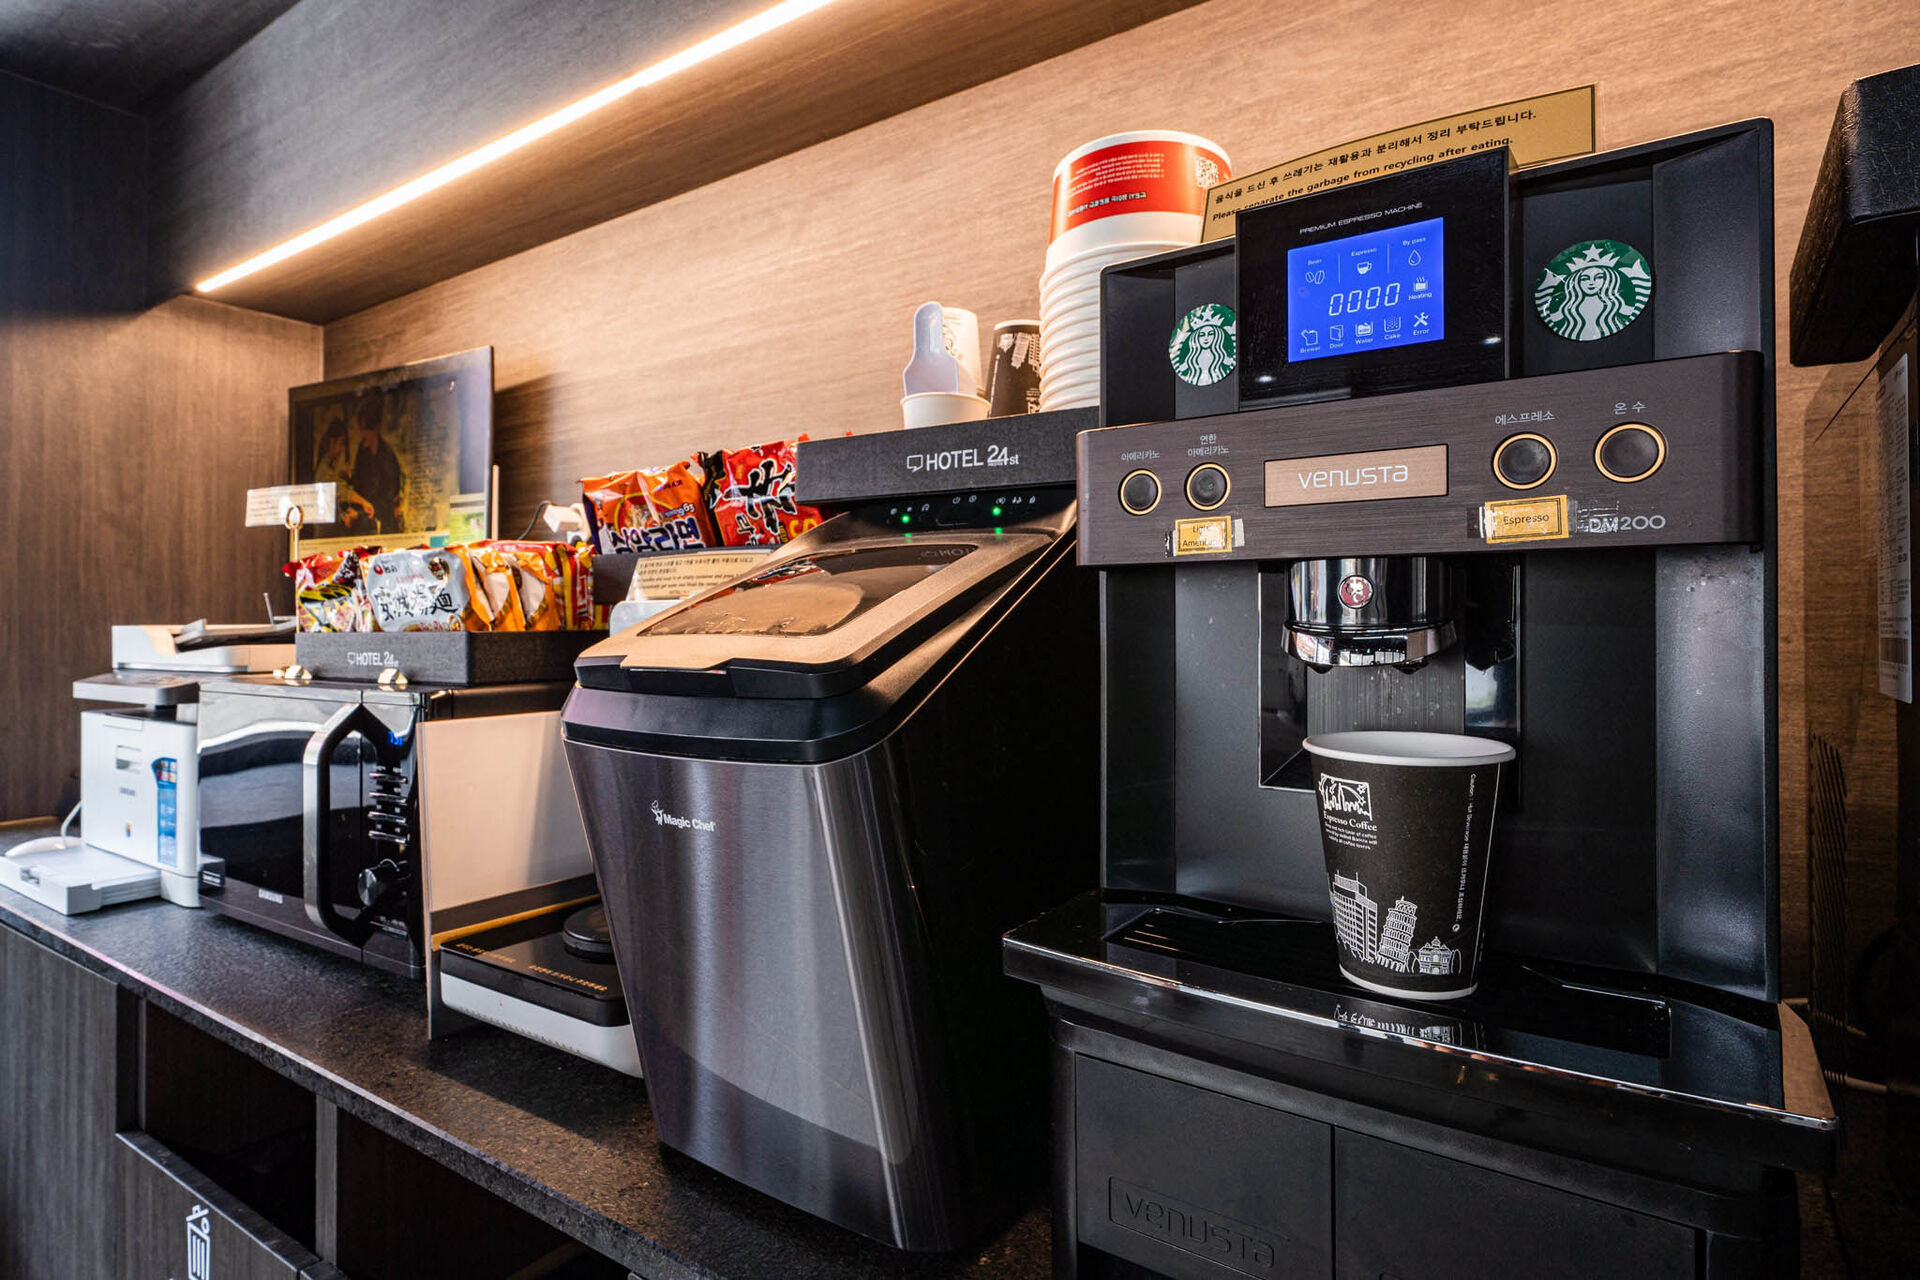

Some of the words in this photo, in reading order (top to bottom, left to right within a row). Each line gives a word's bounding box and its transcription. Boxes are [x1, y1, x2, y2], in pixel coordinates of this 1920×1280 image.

[1215, 186, 1242, 204] 음식을
[1246, 180, 1266, 193] 드신
[1269, 176, 1279, 186] 후
[1282, 161, 1324, 182] 쓰레기는
[1328, 147, 1372, 167] 재활용과
[1376, 134, 1423, 154] 분리해서
[1427, 127, 1451, 142] 정리
[1456, 109, 1537, 135] 부탁드립니다.
[1287, 187, 1304, 197] the
[1306, 173, 1350, 192] garbage
[1353, 166, 1380, 179] from
[1383, 152, 1435, 171] recycling
[1438, 145, 1468, 158] after
[1299, 221, 1336, 235] PREMIUM
[1338, 211, 1383, 226] ESPRESSO
[1384, 201, 1423, 216] MACHINE
[1351, 247, 1377, 257] Espresso
[1328, 282, 1401, 316] 0000
[1408, 291, 1433, 301] Heating
[1384, 333, 1401, 341] Cake
[1413, 328, 1430, 336] Error
[1329, 341, 1344, 349] Door
[1355, 337, 1374, 345] Water
[1300, 345, 1321, 354] Brewer
[1614, 402, 1627, 415] 온
[1631, 401, 1647, 414] 수
[1495, 410, 1555, 426] 에스프레소
[1199, 433, 1217, 445] 연한
[1121, 449, 1160, 462] 아메리카노
[1187, 446, 1230, 457] 아메리카노
[926, 448, 984, 472] HOTEL
[1503, 513, 1550, 527] Espresso
[1588, 514, 1666, 533] DM200
[356, 651, 383, 666] HOTEL
[663, 813, 691, 829] Magic
[691, 818, 716, 832] Chef
[1349, 818, 1378, 832] Coffee
